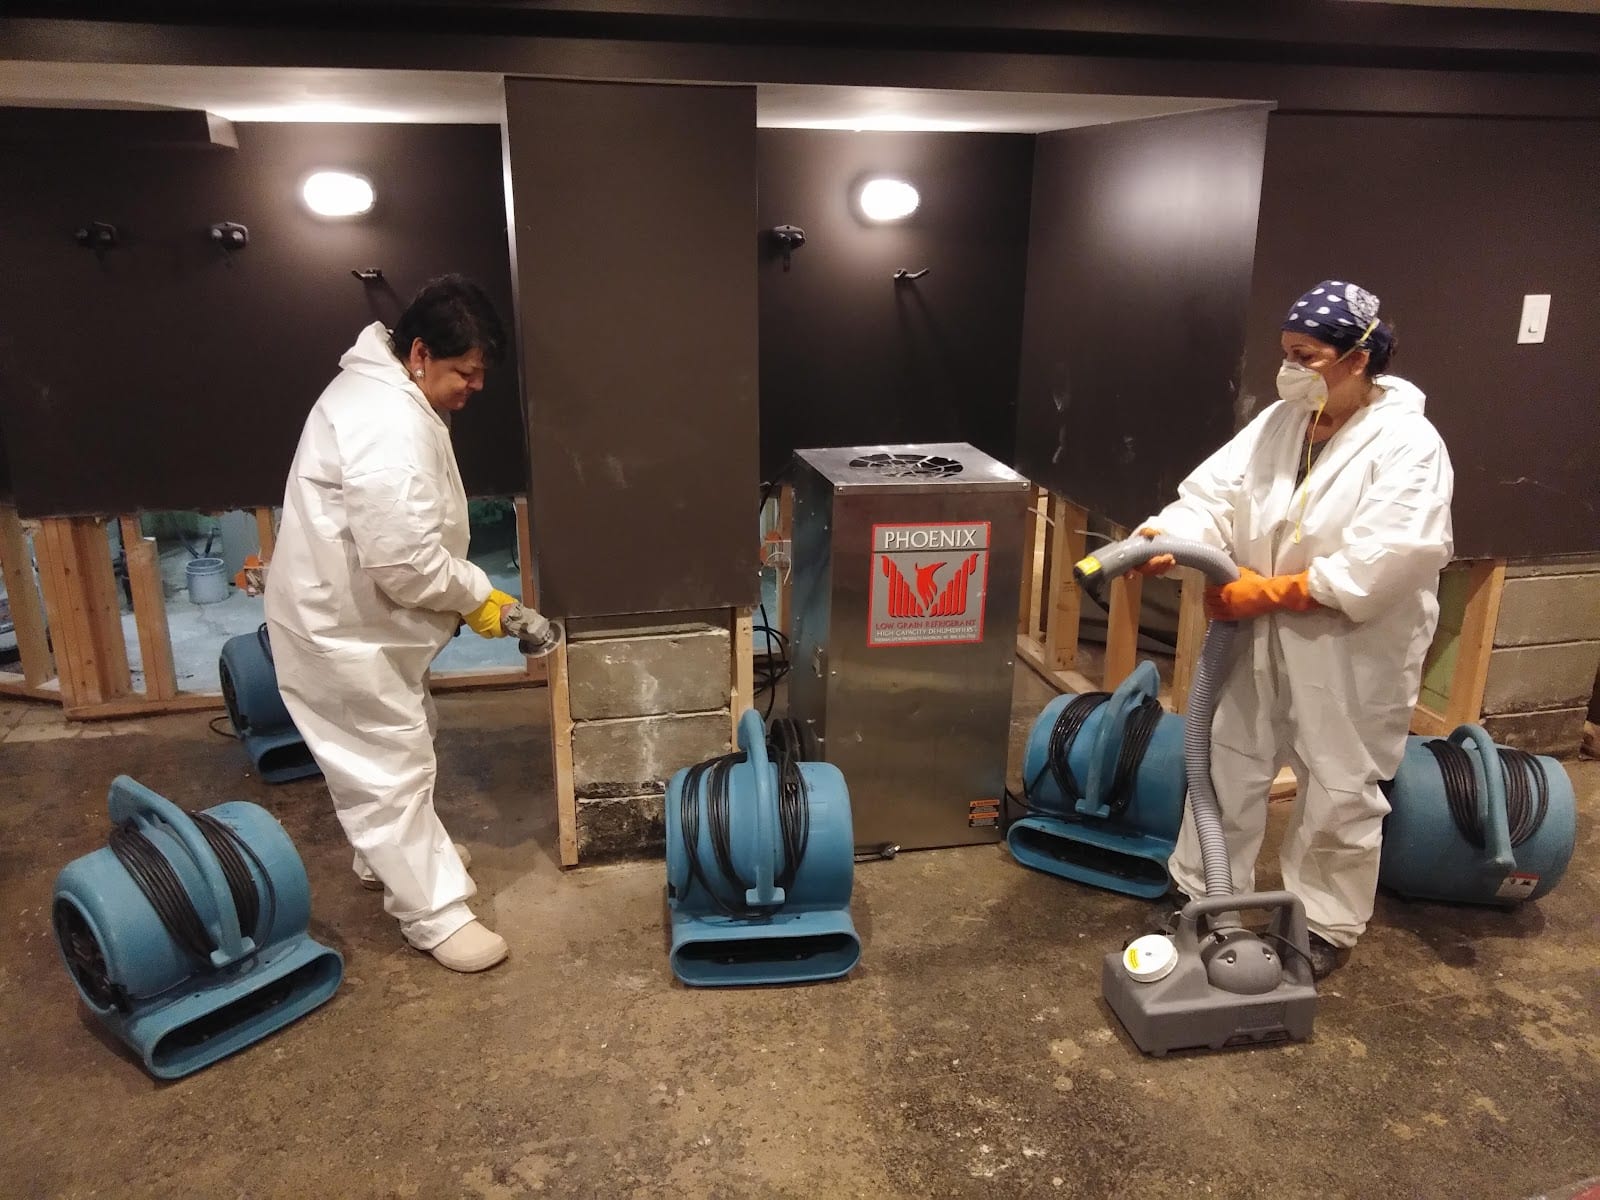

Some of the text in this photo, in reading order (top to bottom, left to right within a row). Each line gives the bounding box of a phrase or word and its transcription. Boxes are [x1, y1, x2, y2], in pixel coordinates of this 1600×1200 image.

[884, 529, 977, 549] PHOENIX
[875, 622, 894, 630] LOW
[896, 621, 922, 630] GRAIN
